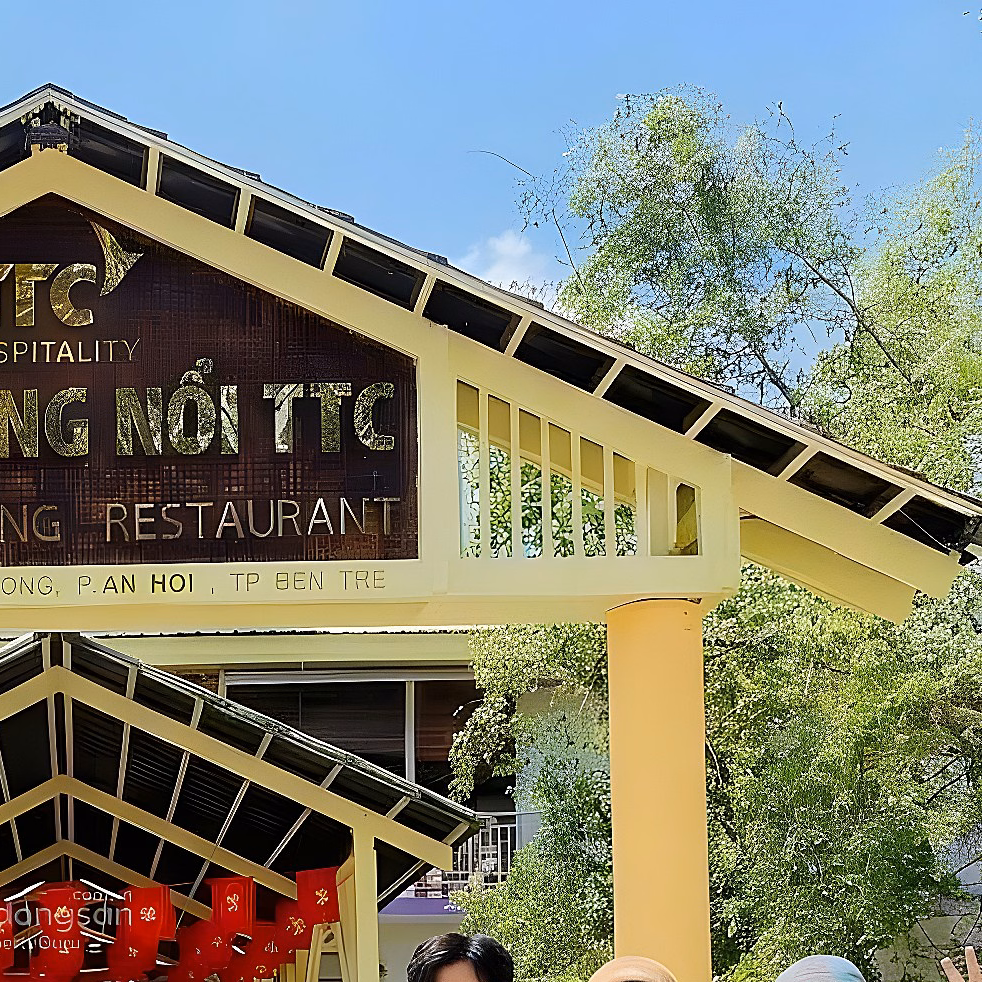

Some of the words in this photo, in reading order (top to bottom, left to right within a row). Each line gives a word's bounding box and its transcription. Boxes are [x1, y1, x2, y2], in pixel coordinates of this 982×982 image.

[115, 357, 239, 456] NỔI
[263, 382, 396, 454] TTC
[106, 497, 401, 543] RESTAURANT
[230, 572, 260, 592] TP
[275, 570, 324, 591] BEN
[339, 570, 386, 590] TRE
